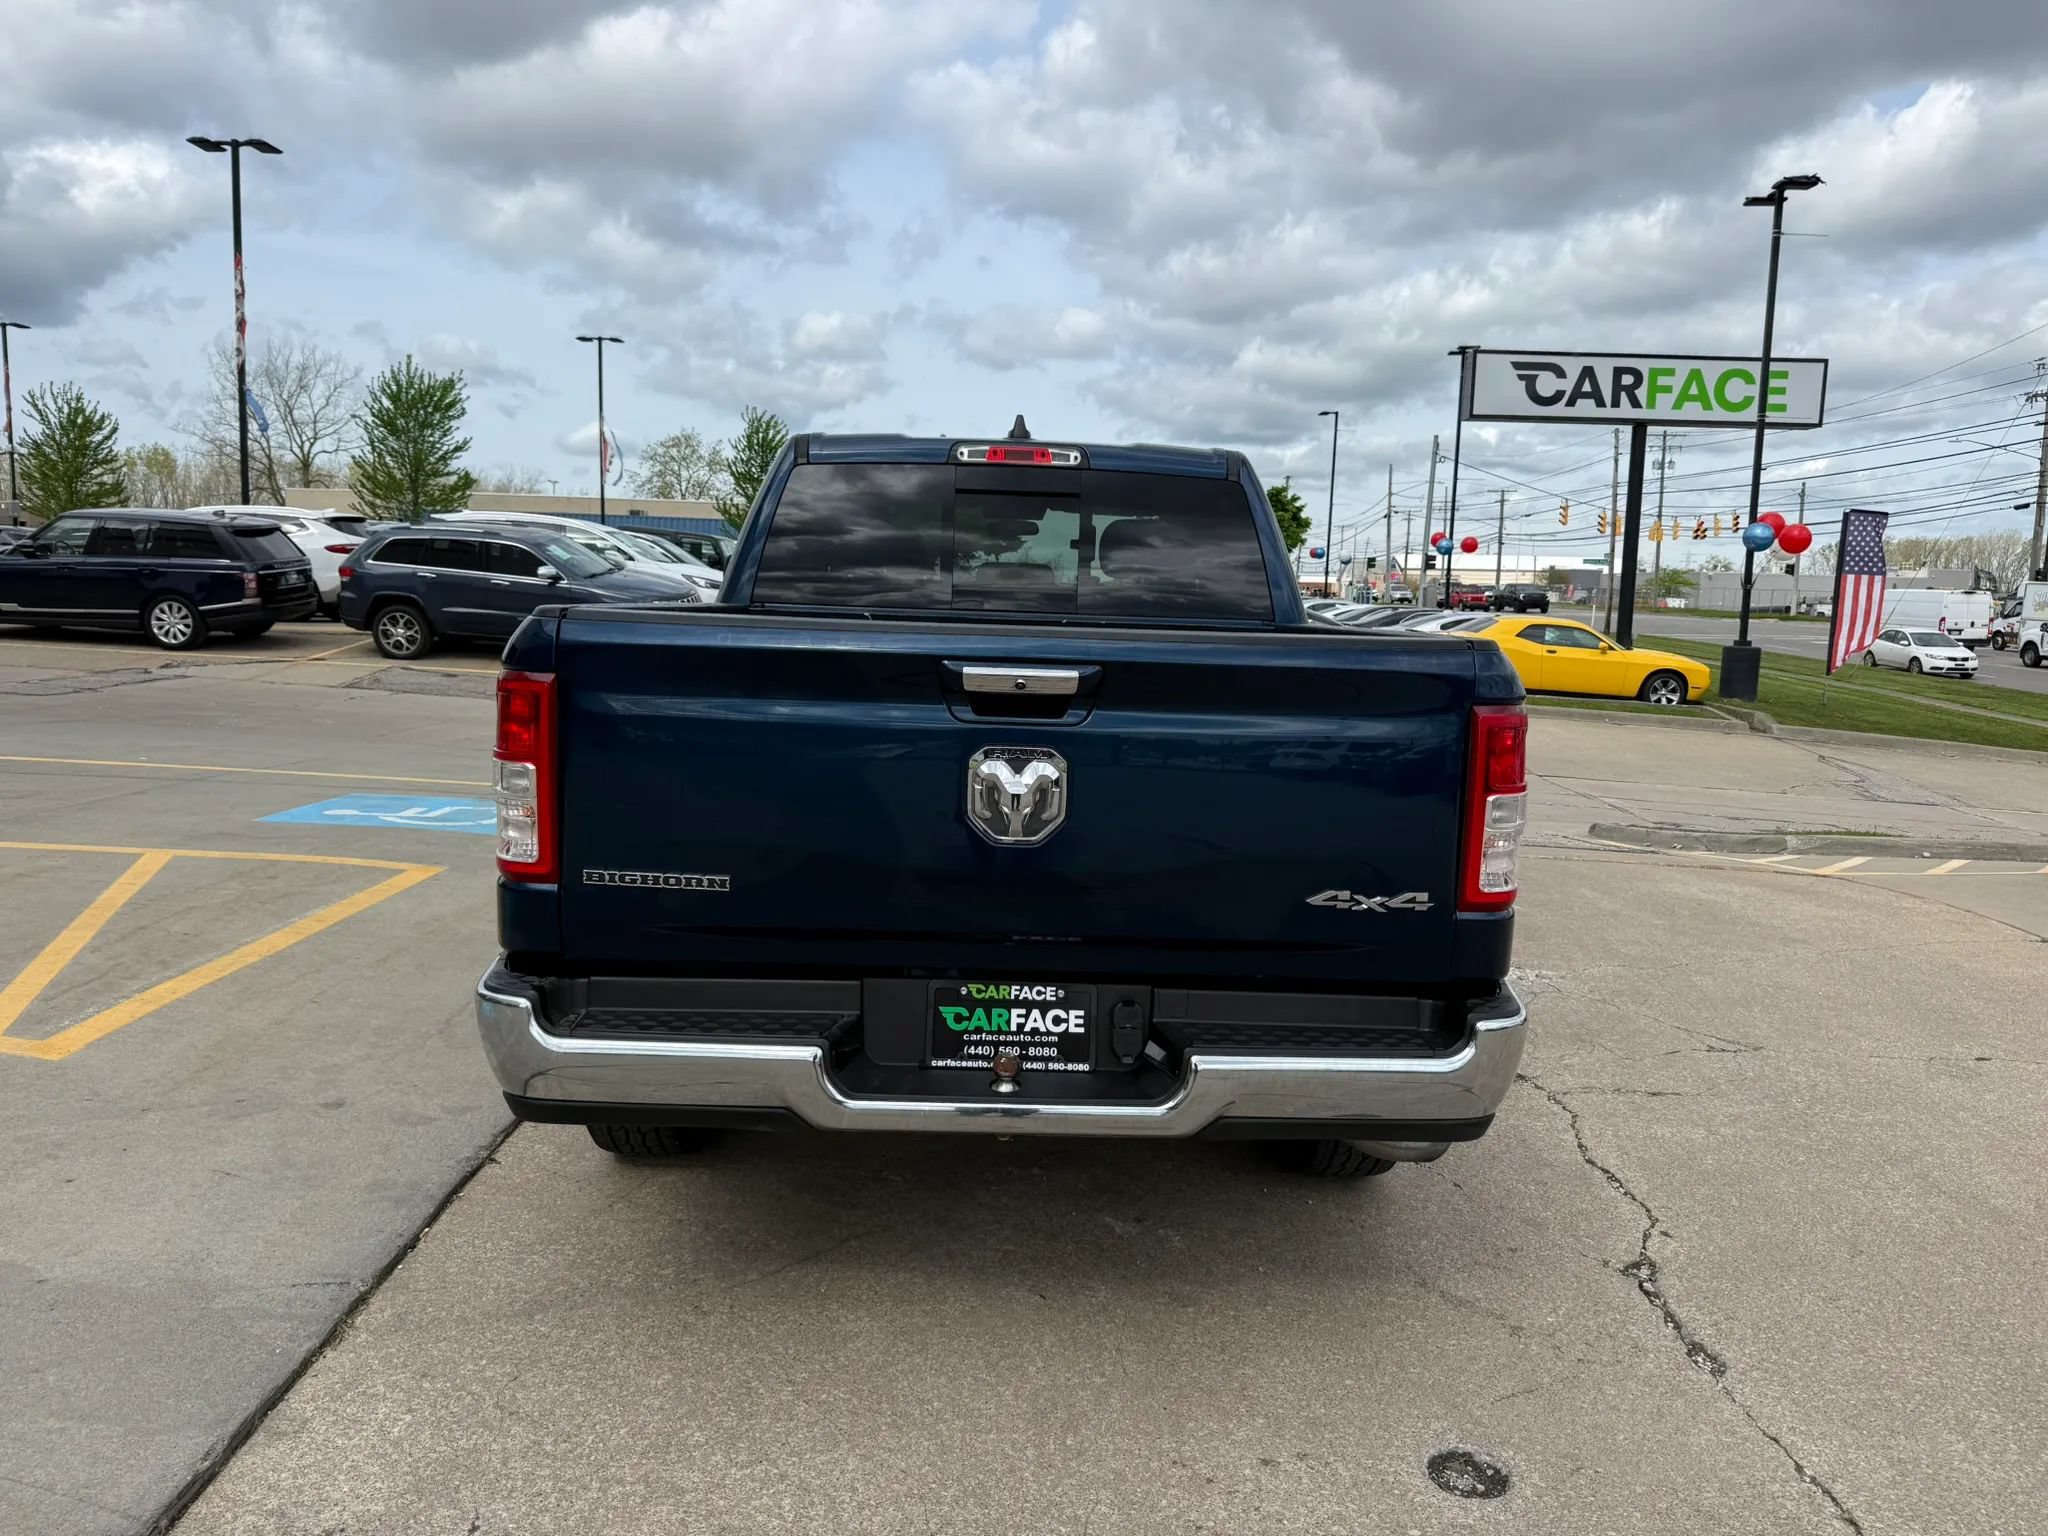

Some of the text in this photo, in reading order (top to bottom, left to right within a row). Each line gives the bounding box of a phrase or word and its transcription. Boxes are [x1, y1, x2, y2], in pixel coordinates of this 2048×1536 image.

[1510, 361, 1790, 413] CARFACE
[988, 749, 1049, 759] RAM
[583, 869, 731, 891] BIGHORN
[967, 983, 1057, 1000] CARFACE
[938, 1006, 1085, 1033] CARFACE
[963, 1032, 1058, 1042] carfaceauto.com
[963, 1045, 995, 1057] (440)
[1022, 1061, 1046, 1070] (440)
[1048, 1062, 1090, 1071] 560-8080
